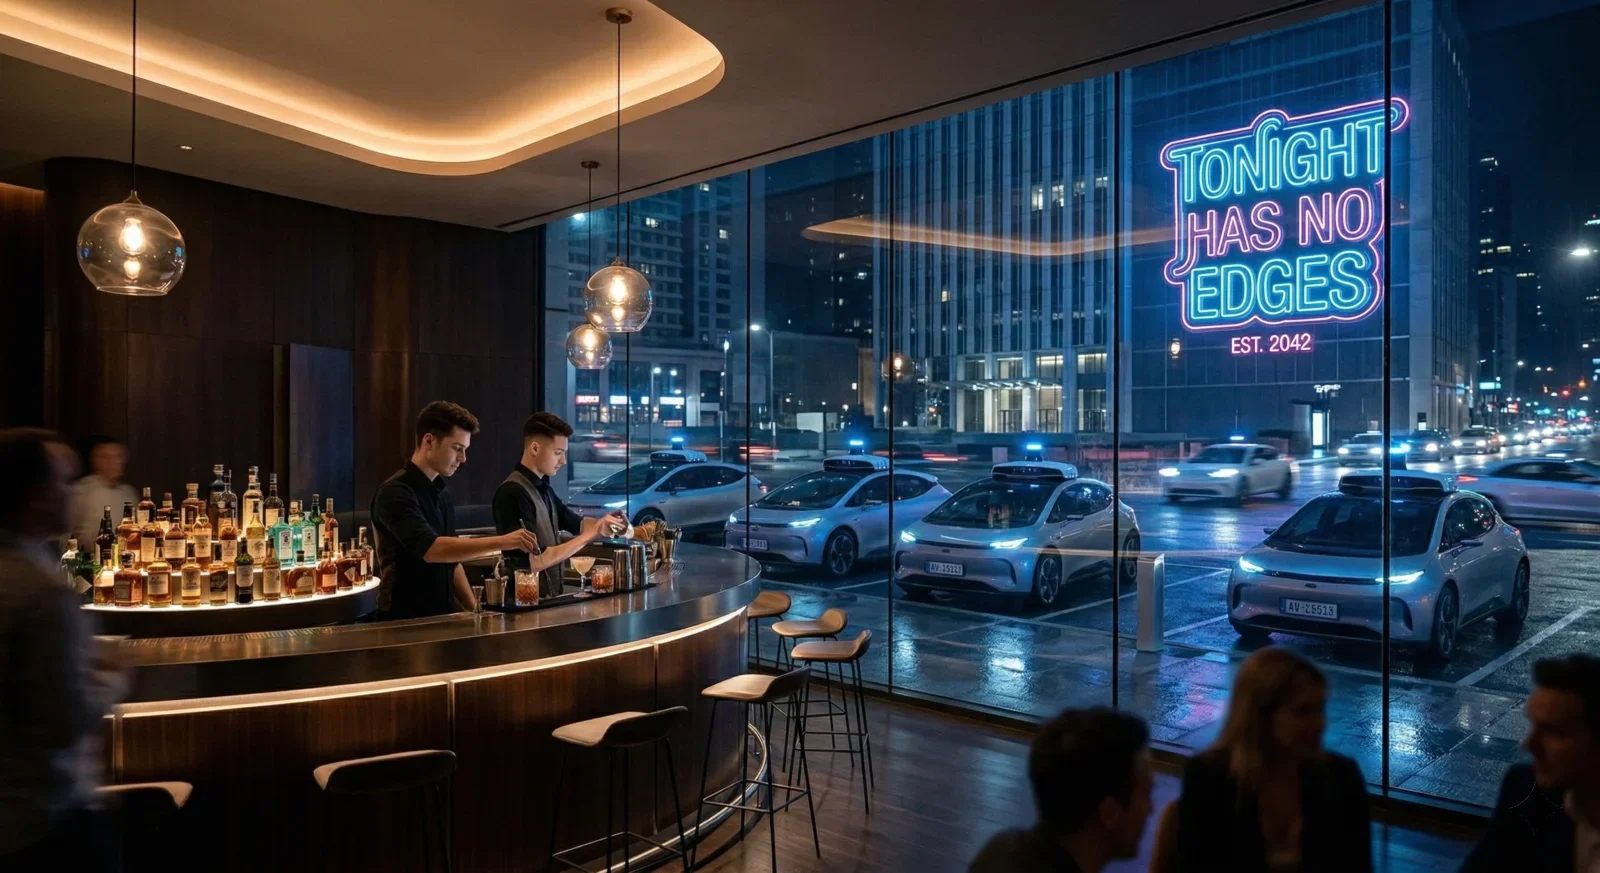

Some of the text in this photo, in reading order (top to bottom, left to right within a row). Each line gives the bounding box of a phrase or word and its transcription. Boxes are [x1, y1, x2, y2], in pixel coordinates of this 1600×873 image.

[1167, 108, 1398, 203] TONIGHT
[1174, 187, 1374, 276] HAS NO
[1190, 250, 1371, 320] EDGES
[1231, 333, 1311, 354] EST. 2042
